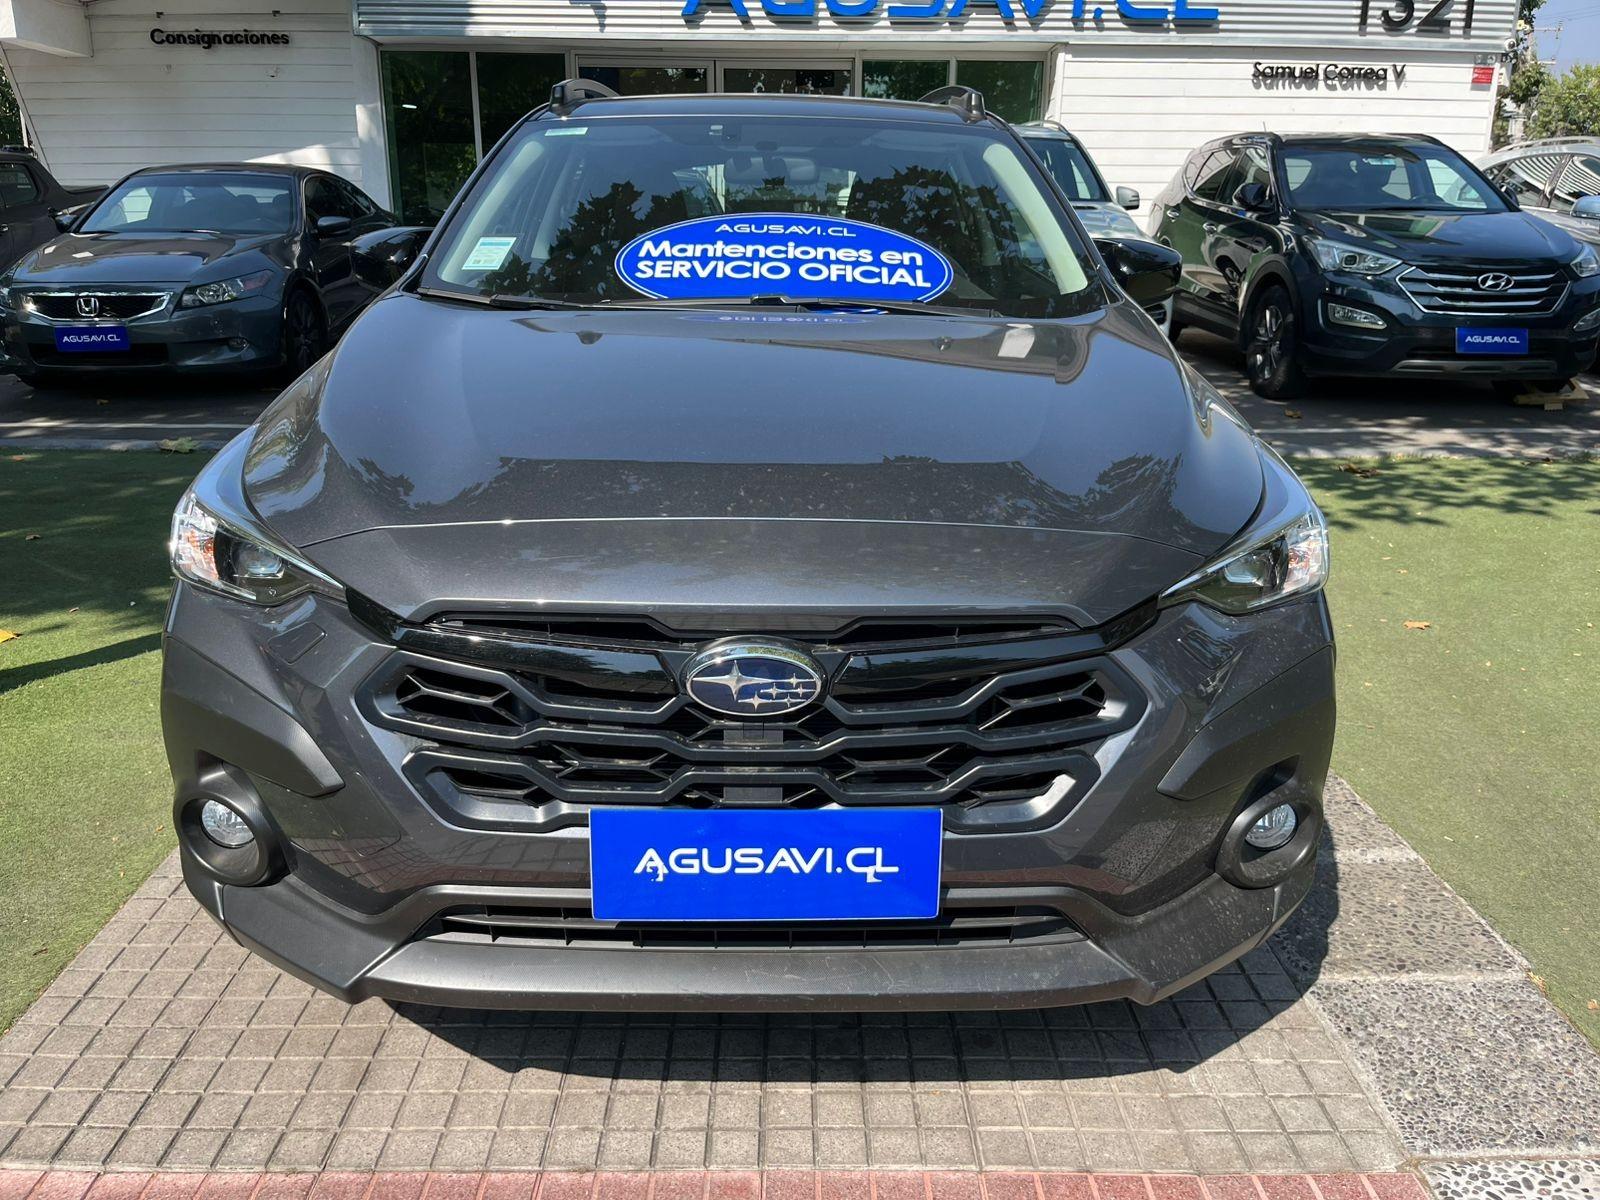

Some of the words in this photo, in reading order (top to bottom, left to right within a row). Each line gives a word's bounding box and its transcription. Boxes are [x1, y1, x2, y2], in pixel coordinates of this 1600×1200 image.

[150, 28, 290, 49] Consignaciones
[1252, 62, 1320, 79] Samuel
[1324, 64, 1388, 80] Correa
[1392, 64, 1406, 79] V
[715, 223, 857, 237] AGUSAVI.CL
[638, 240, 872, 263] Mantenciones
[880, 248, 922, 266] en
[635, 260, 791, 280] SERVICIO
[798, 263, 931, 288] OFICIAL
[62, 334, 121, 343] AGUSAVI.CL
[1465, 335, 1520, 344] AGUSAVI.CL
[633, 847, 899, 875] AGUSAVI.CL
